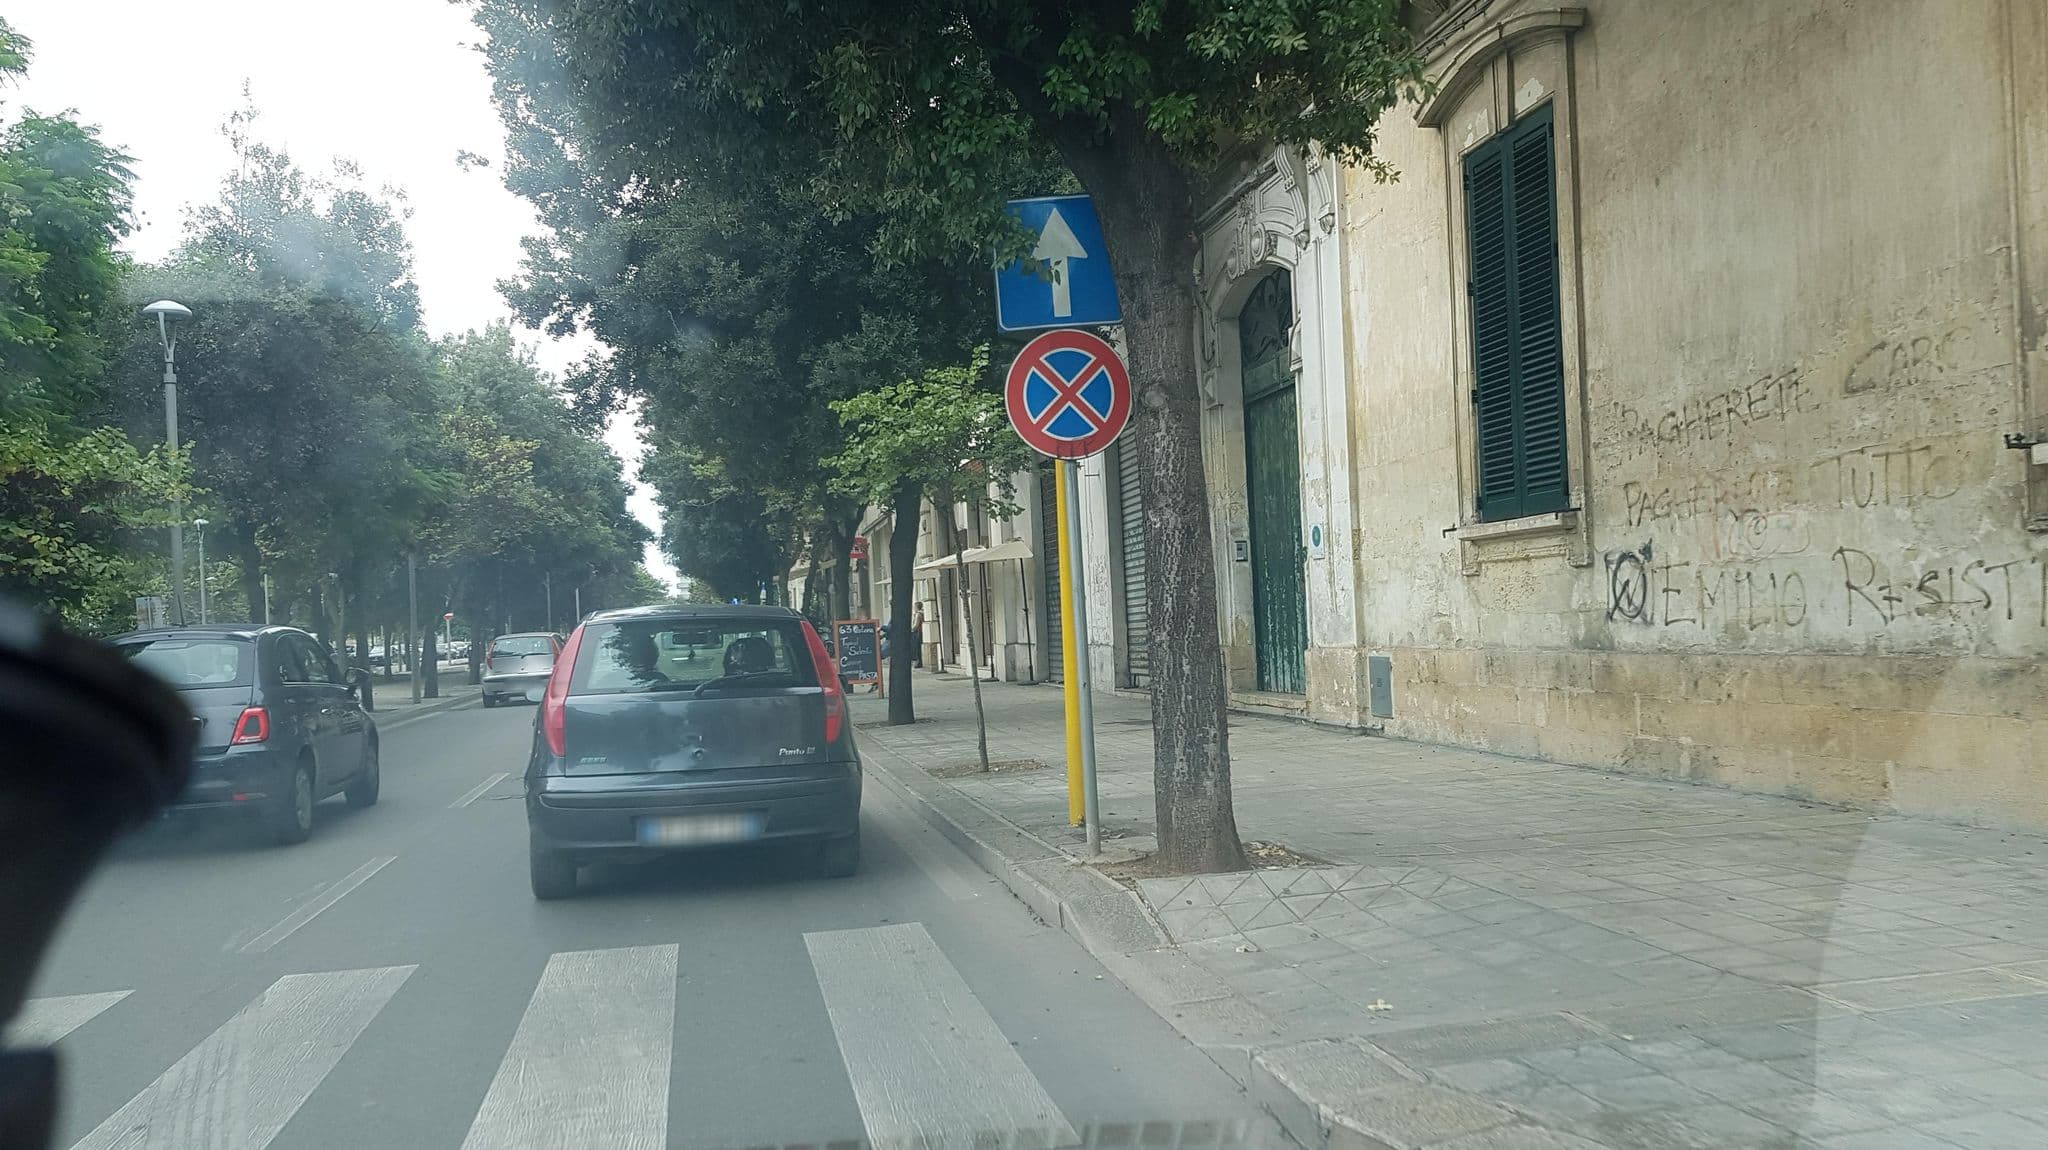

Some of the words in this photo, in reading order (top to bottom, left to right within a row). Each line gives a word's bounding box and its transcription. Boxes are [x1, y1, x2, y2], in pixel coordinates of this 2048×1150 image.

[1621, 468, 1795, 526] PAGHER
[1810, 444, 1963, 510] TUTTO
[1655, 552, 1808, 631] EMILIO
[839, 625, 852, 635] 63
[858, 671, 878, 680] PASTA
[778, 747, 805, 756] Punto
